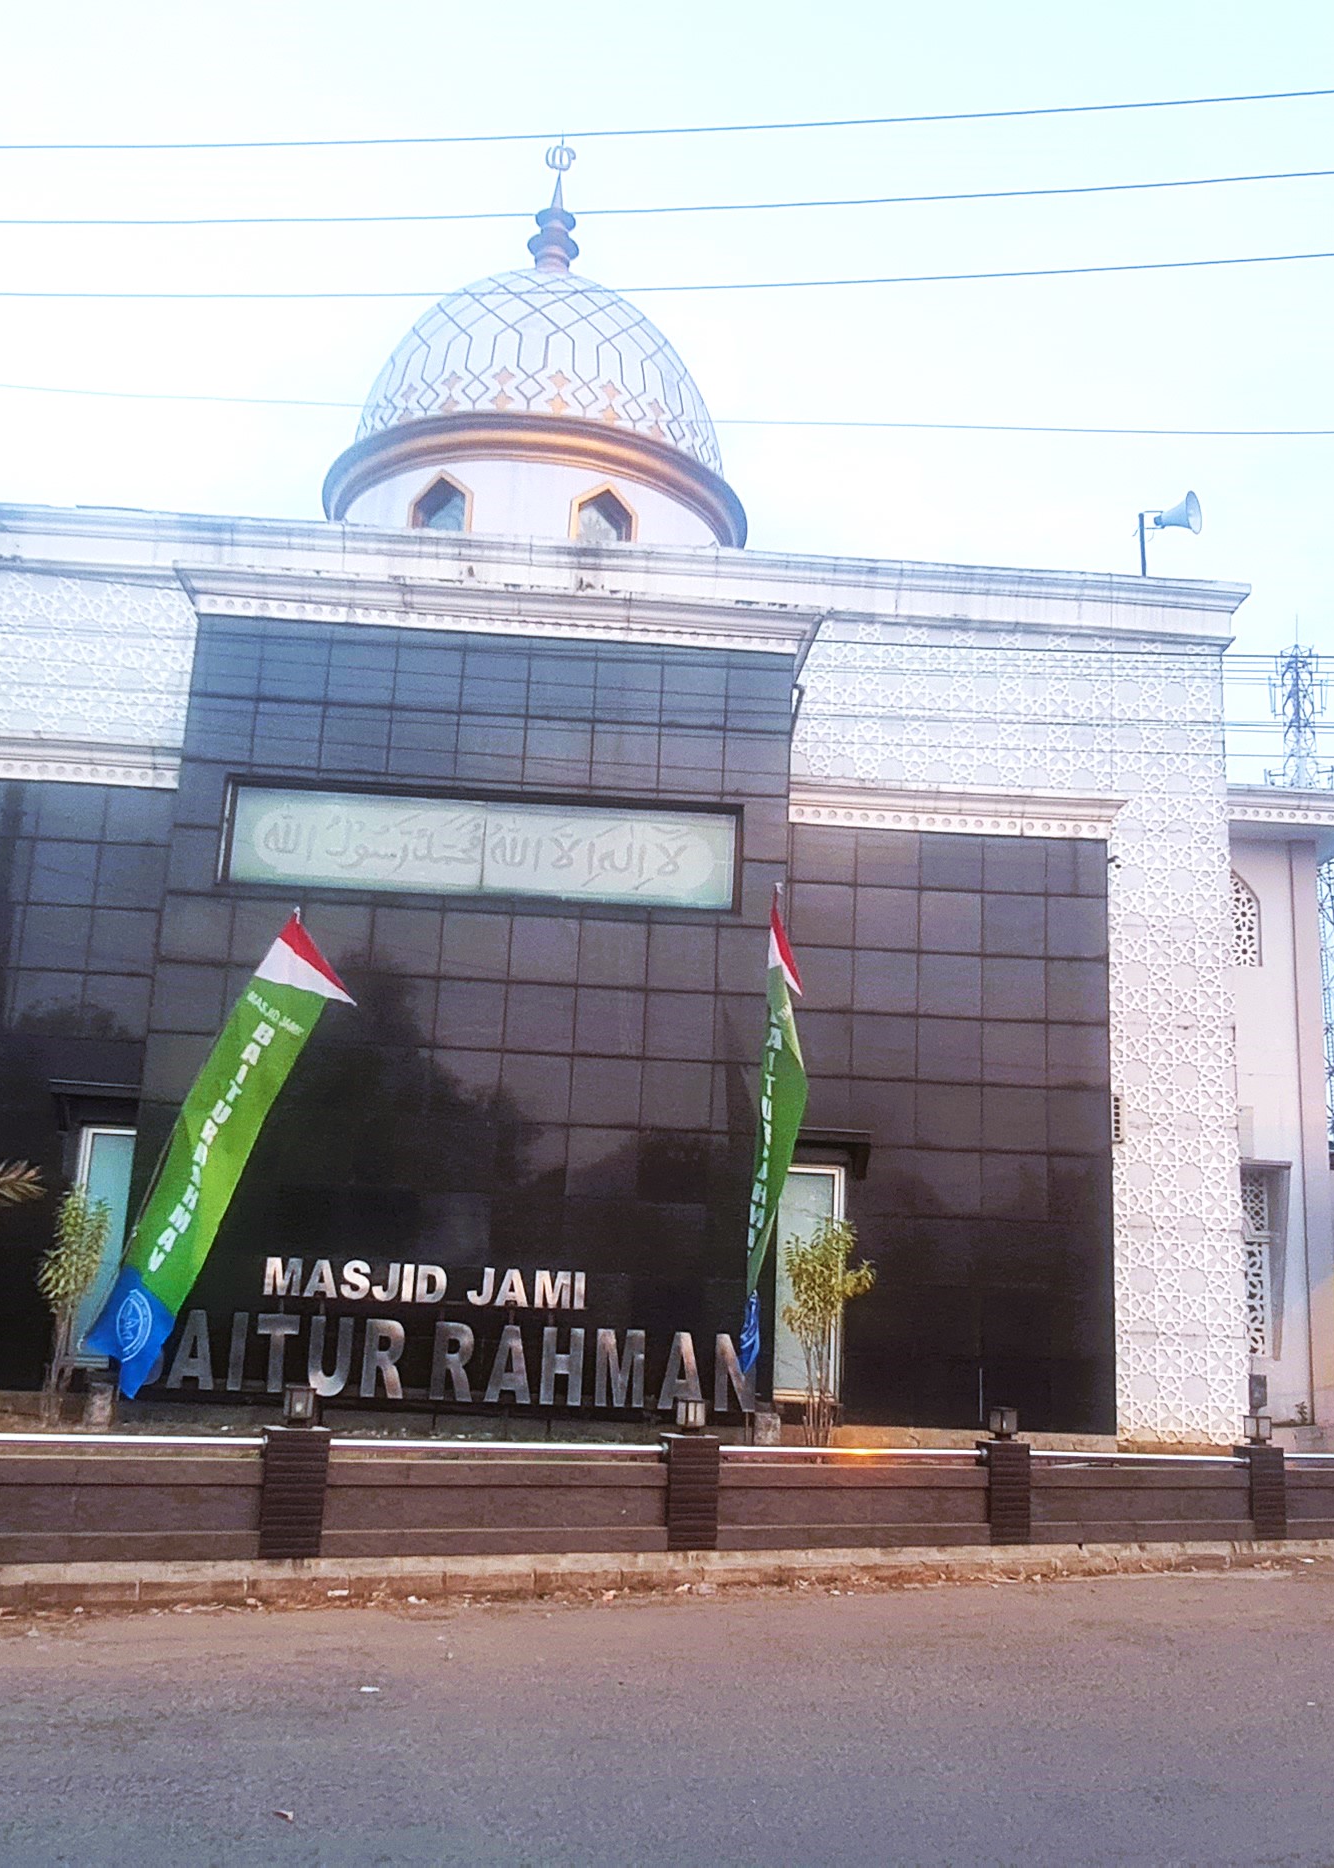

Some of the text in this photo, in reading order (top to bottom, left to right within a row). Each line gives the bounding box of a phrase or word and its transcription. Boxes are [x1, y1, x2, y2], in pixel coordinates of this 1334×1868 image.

[263, 1256, 587, 1310] MASJID JAMI
[143, 1310, 405, 1399] AITUR
[427, 1322, 757, 1412] RAHMAN
